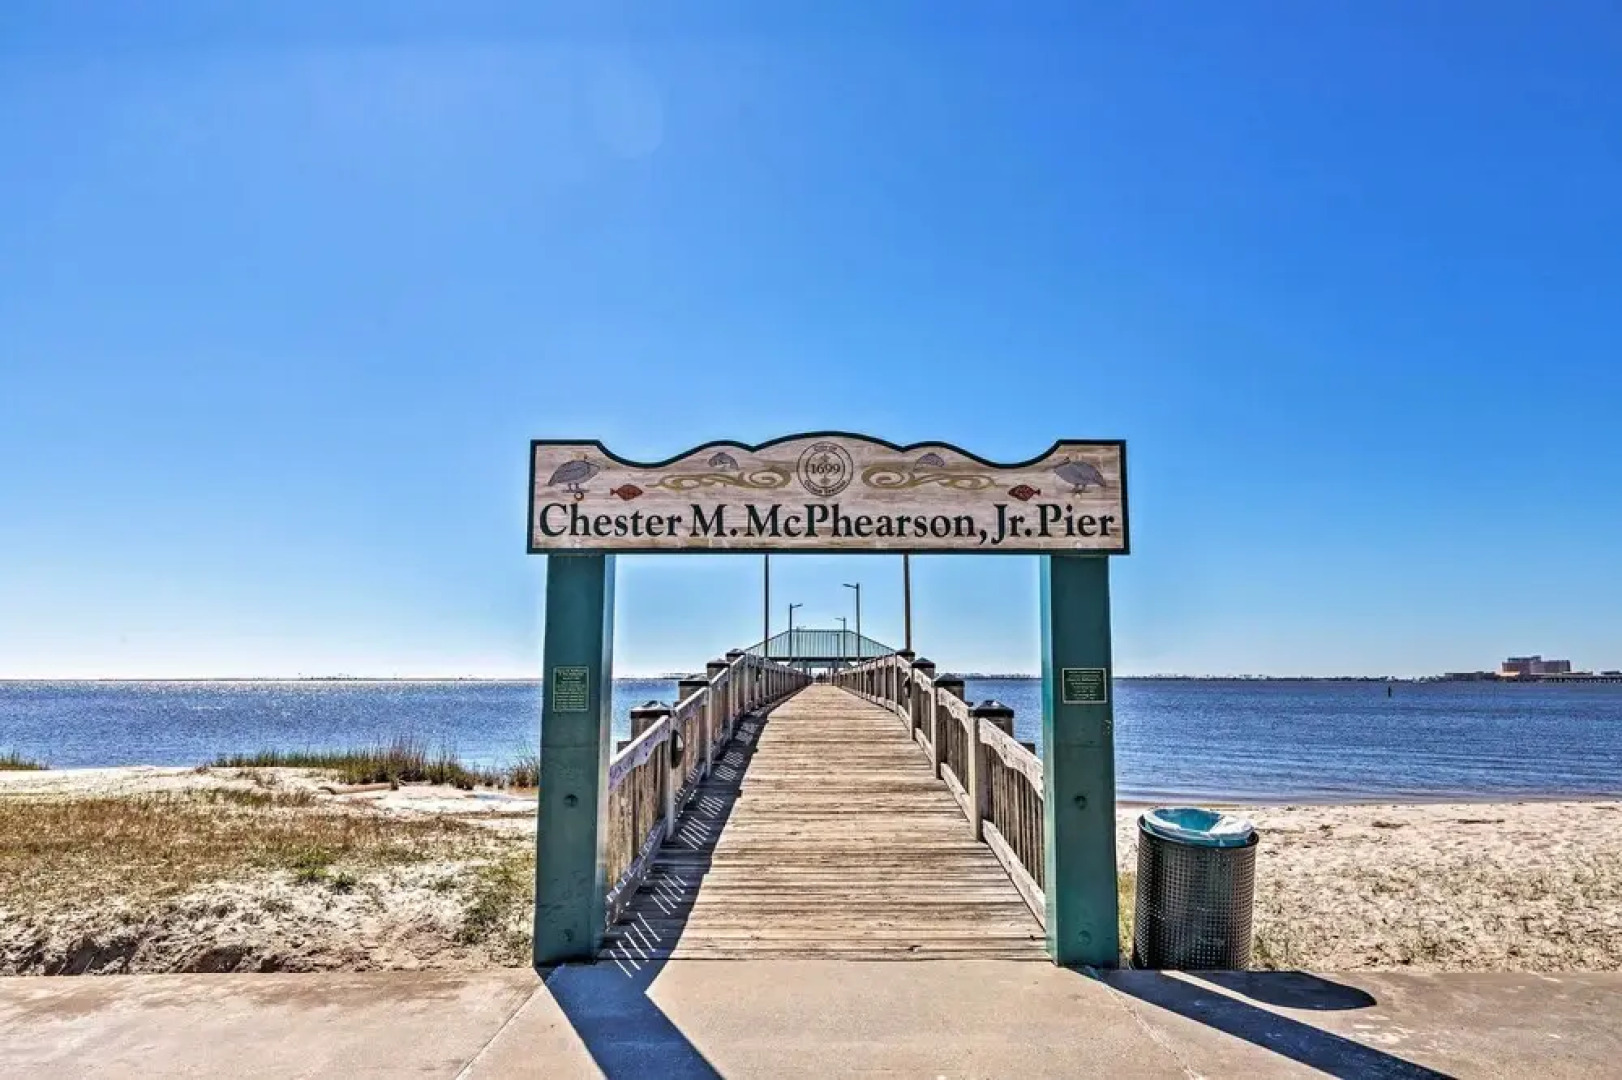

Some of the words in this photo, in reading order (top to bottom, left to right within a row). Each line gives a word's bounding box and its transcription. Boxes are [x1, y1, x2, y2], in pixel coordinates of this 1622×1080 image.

[810, 463, 841, 474] 1699
[539, 502, 682, 538] Chester
[689, 503, 738, 538] M.
[745, 502, 987, 545] McPhearson,
[991, 503, 1032, 545] Jr.
[1037, 503, 1114, 538] Pier
